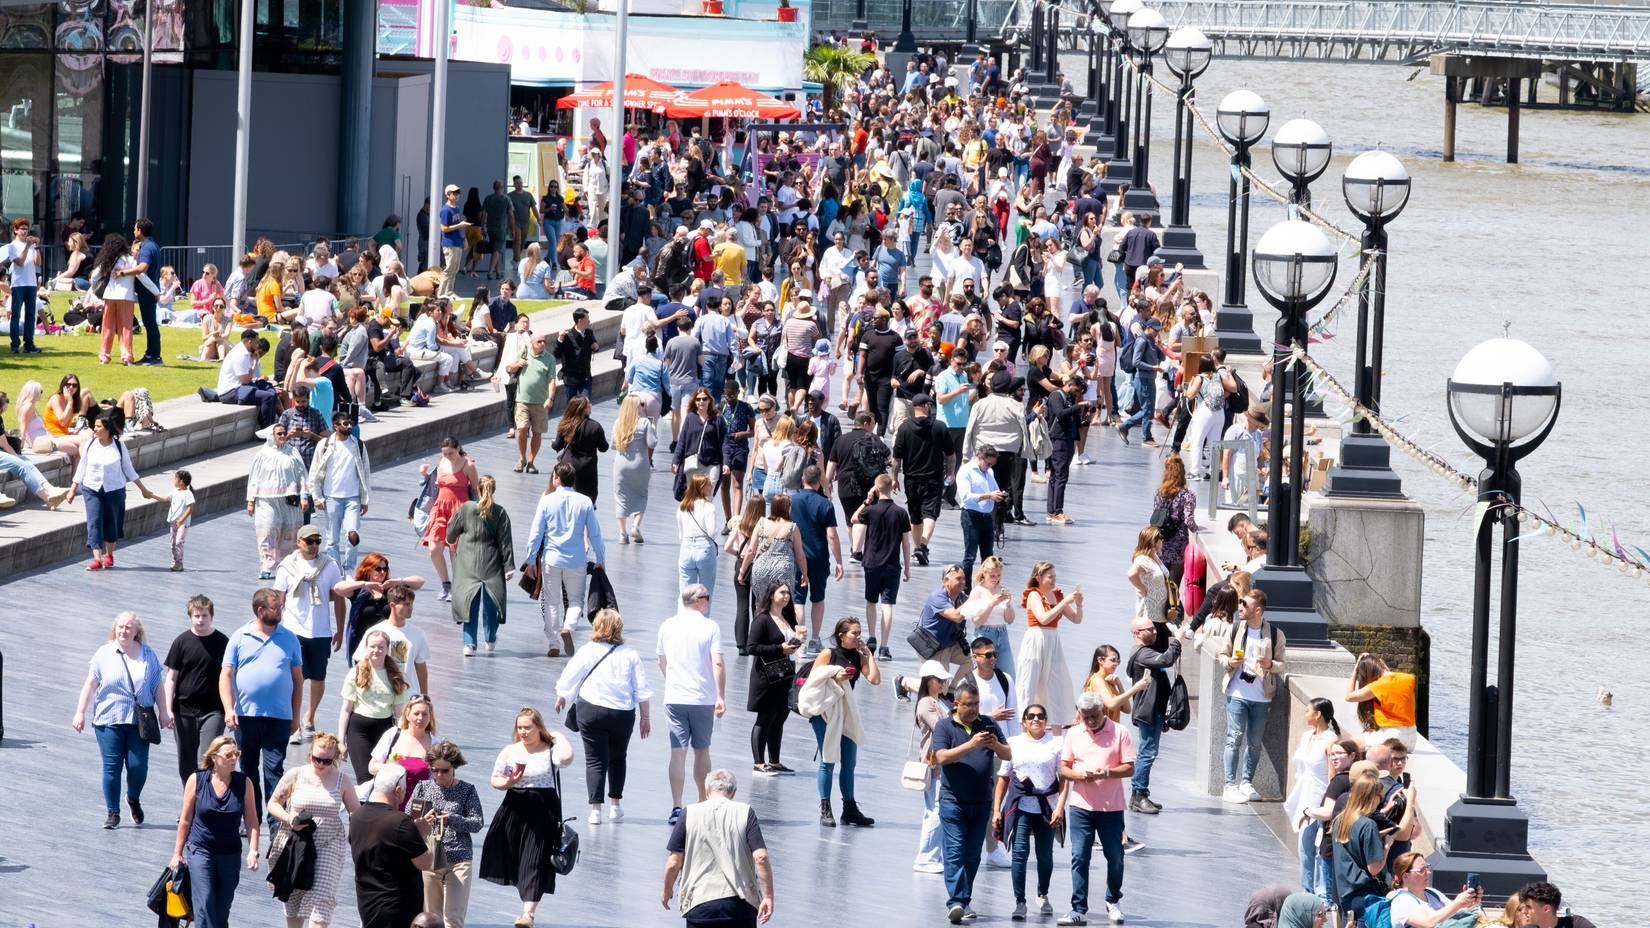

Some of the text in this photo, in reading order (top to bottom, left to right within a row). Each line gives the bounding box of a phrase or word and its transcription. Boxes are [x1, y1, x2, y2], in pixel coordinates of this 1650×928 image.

[591, 99, 603, 107] FOR
[603, 99, 609, 107] A
[711, 98, 752, 106] PIMM'S
[733, 108, 760, 118] O'CLOCK
